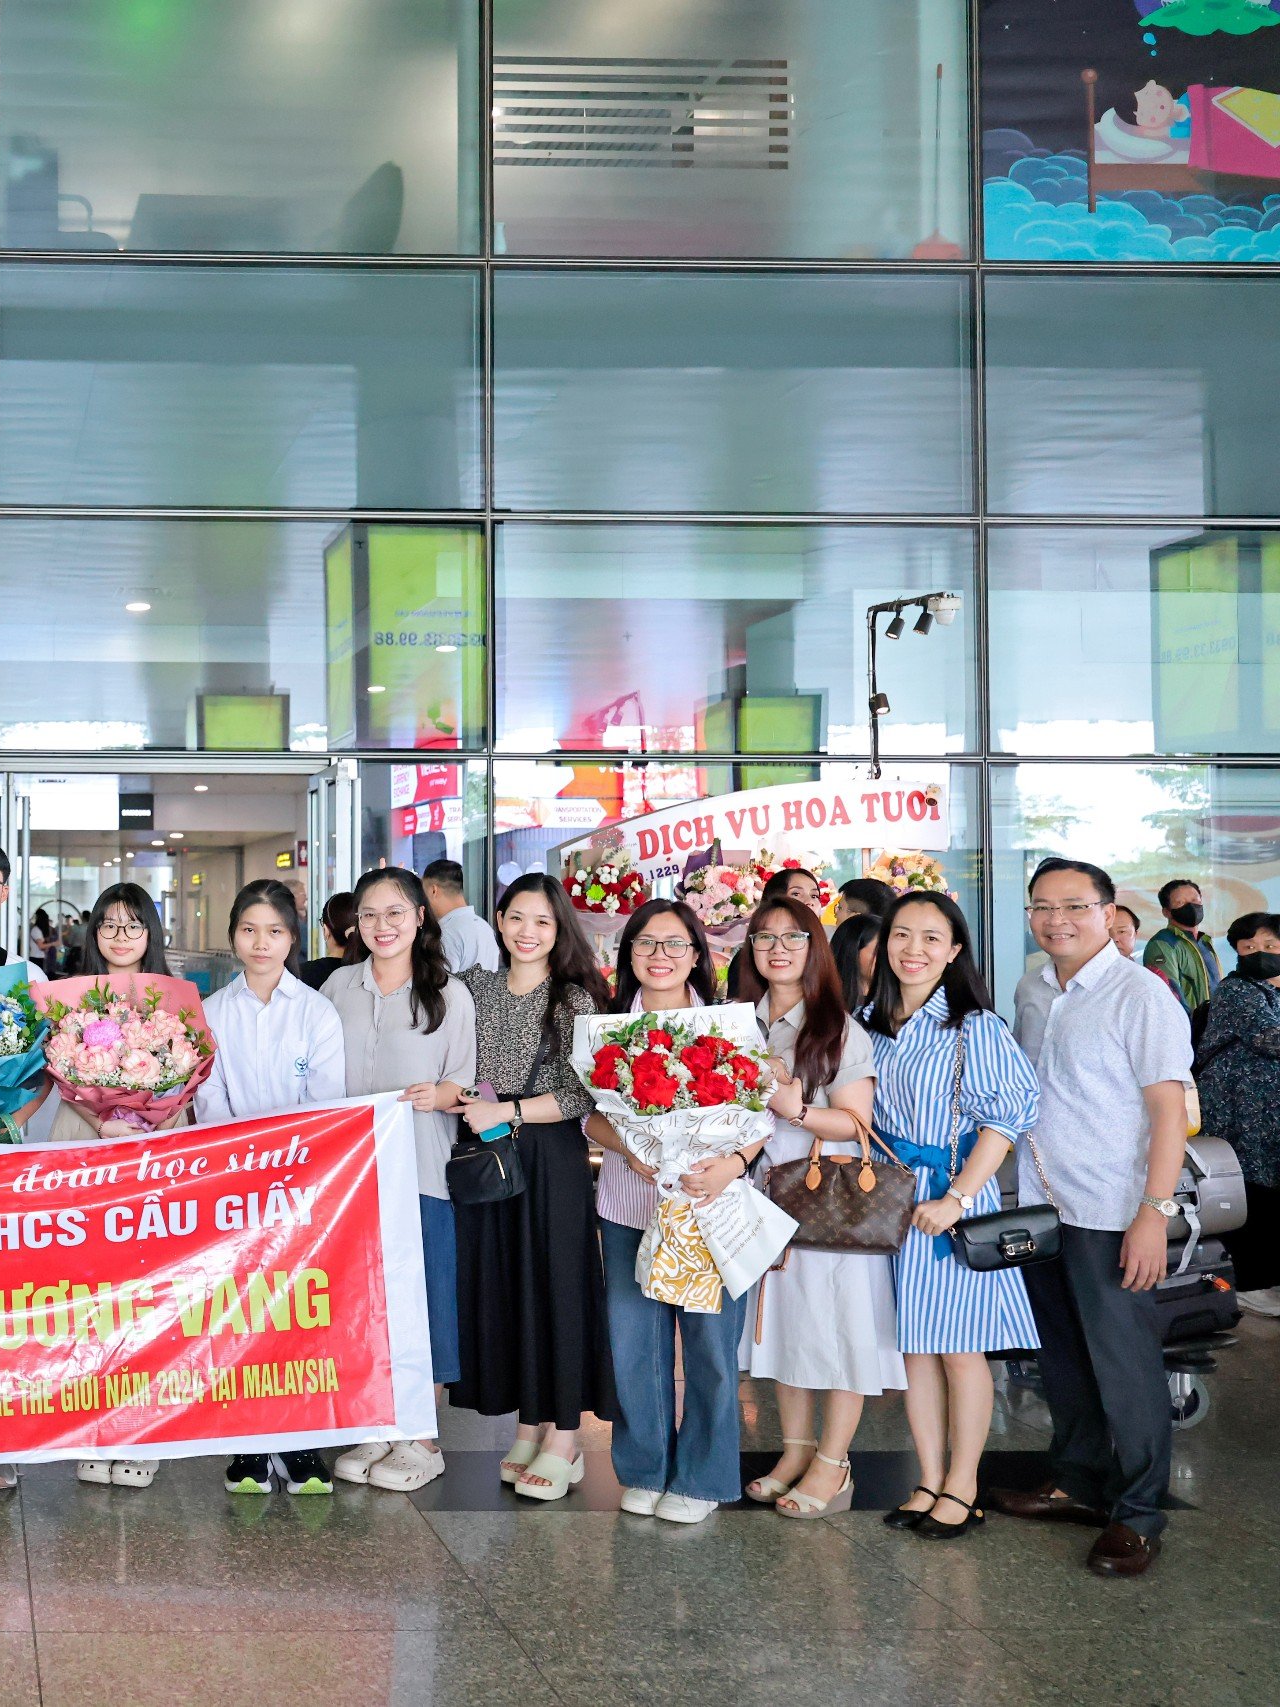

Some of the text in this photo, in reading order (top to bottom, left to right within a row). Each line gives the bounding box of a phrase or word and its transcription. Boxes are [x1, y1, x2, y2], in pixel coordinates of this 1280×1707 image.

[636, 814, 716, 862] DỊCH
[783, 795, 851, 832] HOA
[12, 1160, 124, 1196] đoàn
[136, 1150, 211, 1186] học
[225, 1134, 313, 1174] sinh
[104, 1190, 198, 1243] CẦU
[215, 1174, 318, 1231] GIẤY
[104, 1364, 151, 1408] NĂM
[157, 1371, 204, 1405] 2024
[209, 1367, 237, 1409] TẠI
[242, 1357, 340, 1398] MALAYSIA
